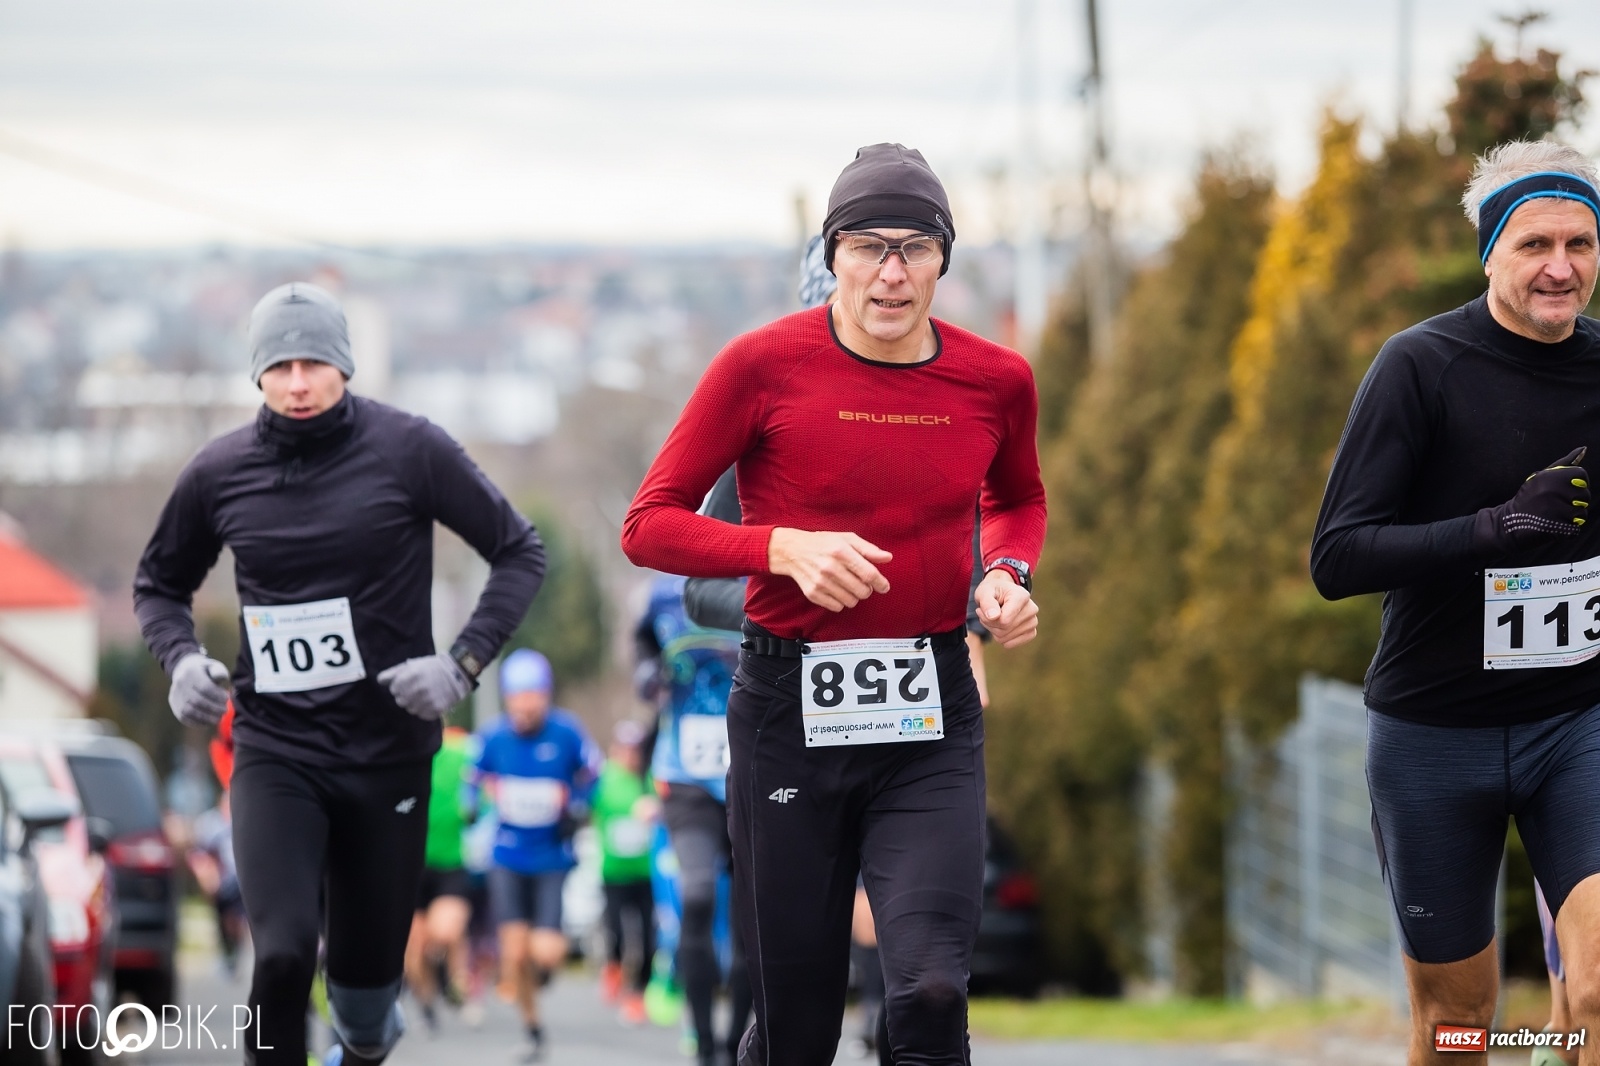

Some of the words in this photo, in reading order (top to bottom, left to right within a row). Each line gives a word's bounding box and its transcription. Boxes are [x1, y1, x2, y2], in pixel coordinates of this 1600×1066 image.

[838, 411, 950, 424] BRUBECK
[260, 634, 351, 673] 103
[810, 658, 930, 707] 258
[809, 722, 896, 735] www.personalbest.pl
[768, 787, 799, 804] 4F
